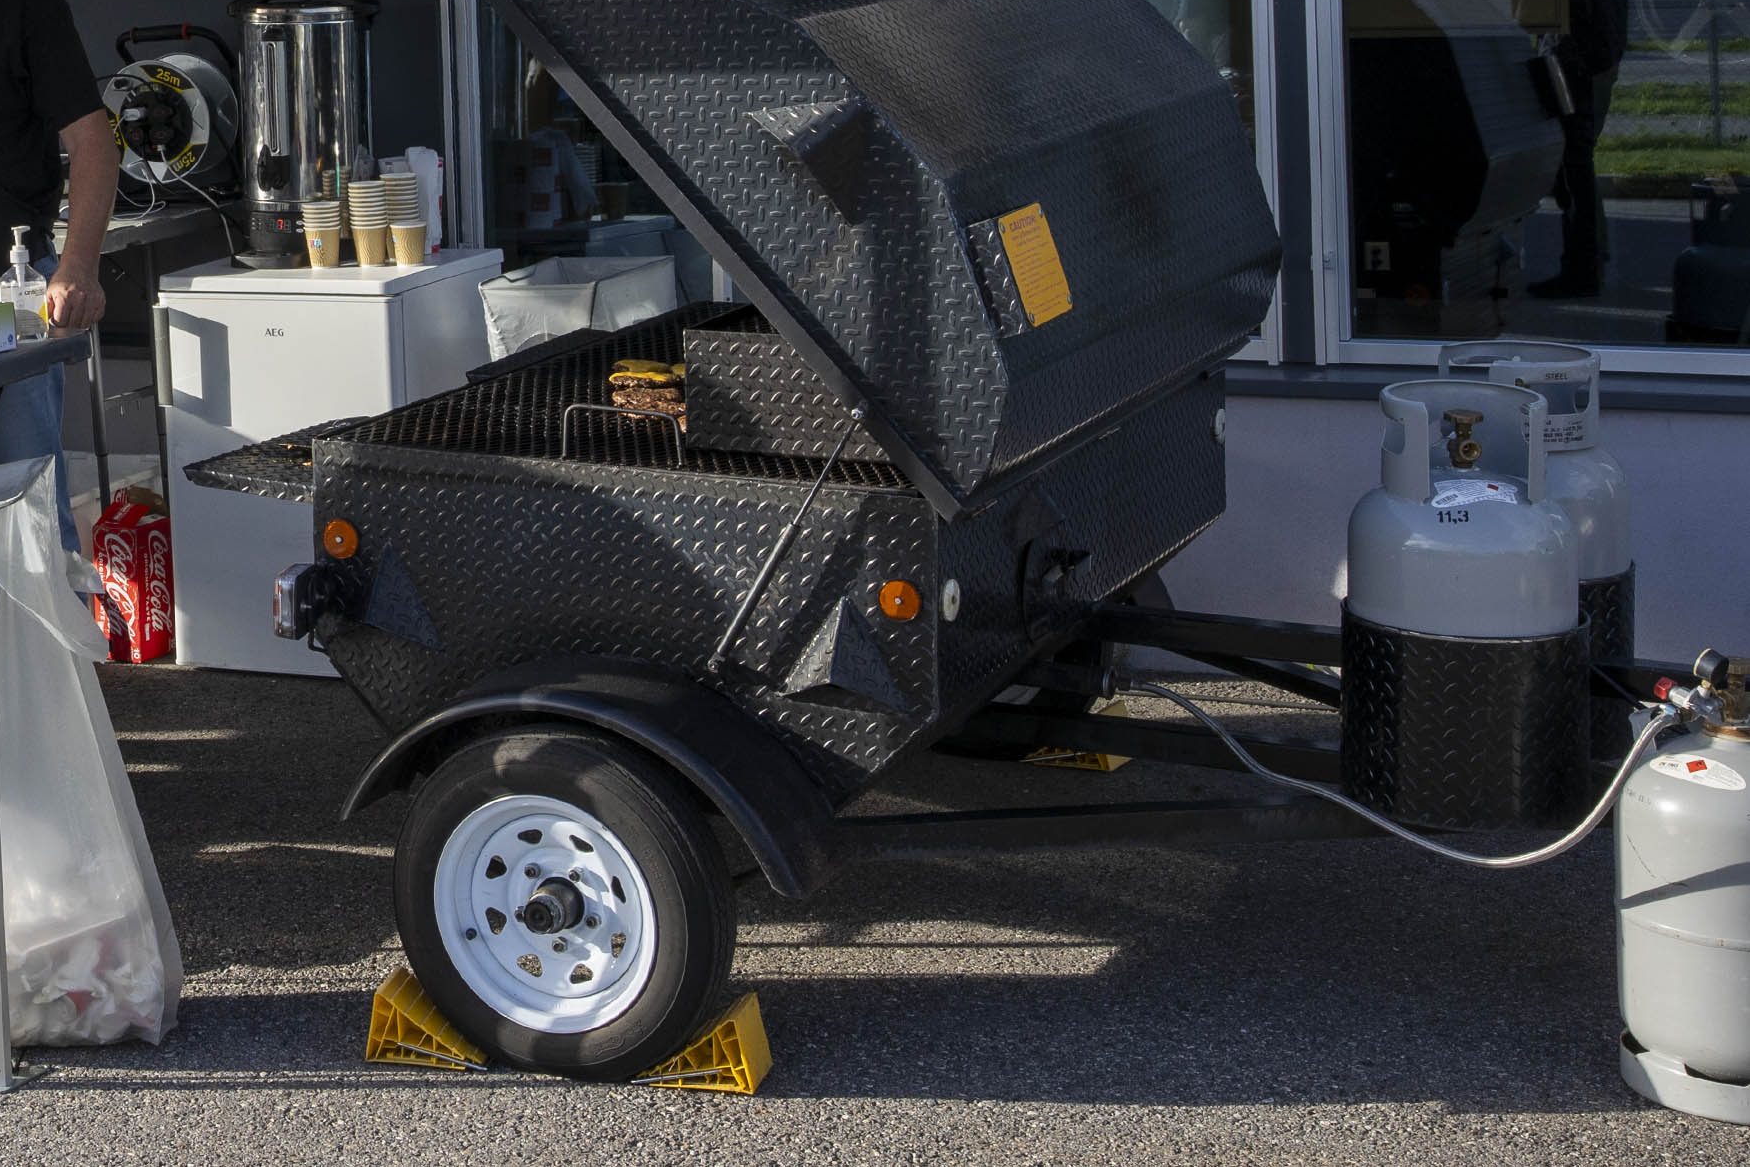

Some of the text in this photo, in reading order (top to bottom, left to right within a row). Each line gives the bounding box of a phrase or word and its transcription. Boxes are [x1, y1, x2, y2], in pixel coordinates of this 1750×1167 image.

[155, 67, 181, 87] 25m
[172, 150, 196, 172] 25m
[264, 328, 285, 338] AEG
[1545, 372, 1568, 380] STEEL
[1436, 509, 1470, 525] 11,3
